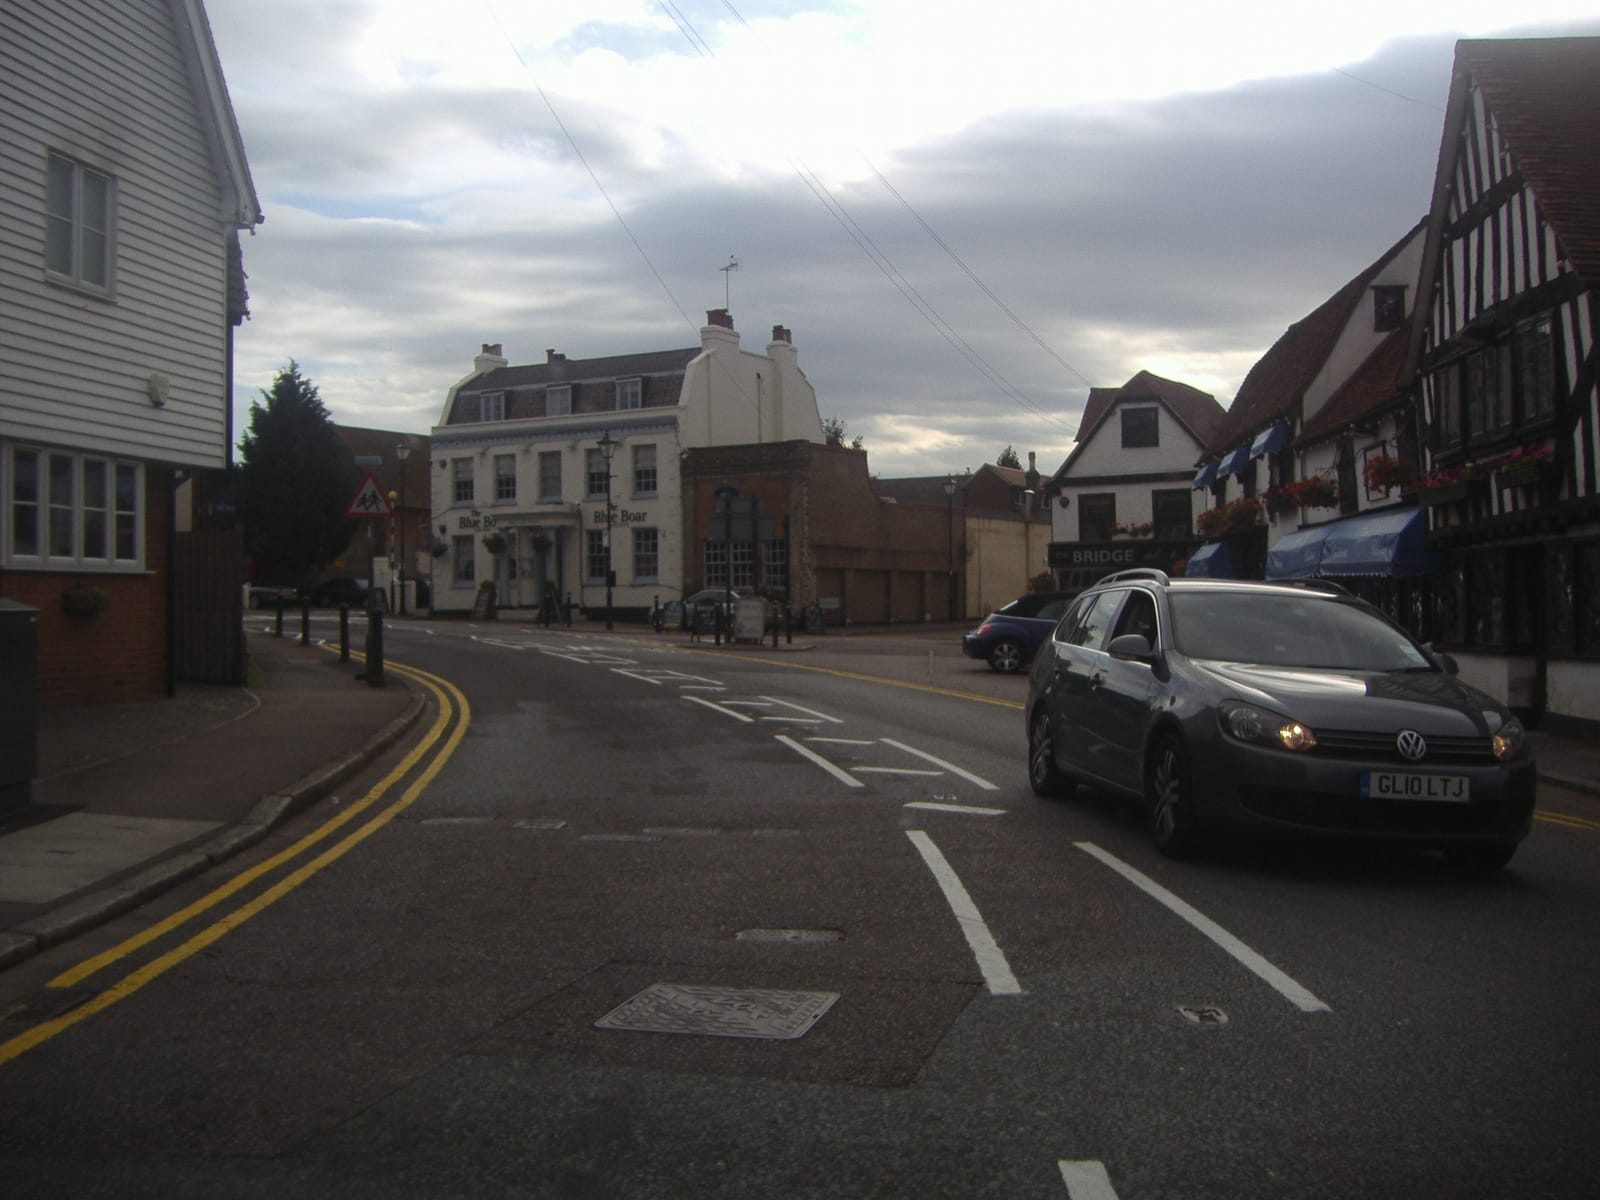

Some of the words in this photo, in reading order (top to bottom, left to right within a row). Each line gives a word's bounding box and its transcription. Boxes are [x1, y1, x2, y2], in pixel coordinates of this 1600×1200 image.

[459, 516, 481, 529] Blue
[483, 515, 497, 529] Bo
[621, 509, 648, 523] Boar
[1072, 549, 1135, 563] BRIDGE
[1378, 775, 1422, 796] GL10
[1427, 776, 1464, 798] LTJ
